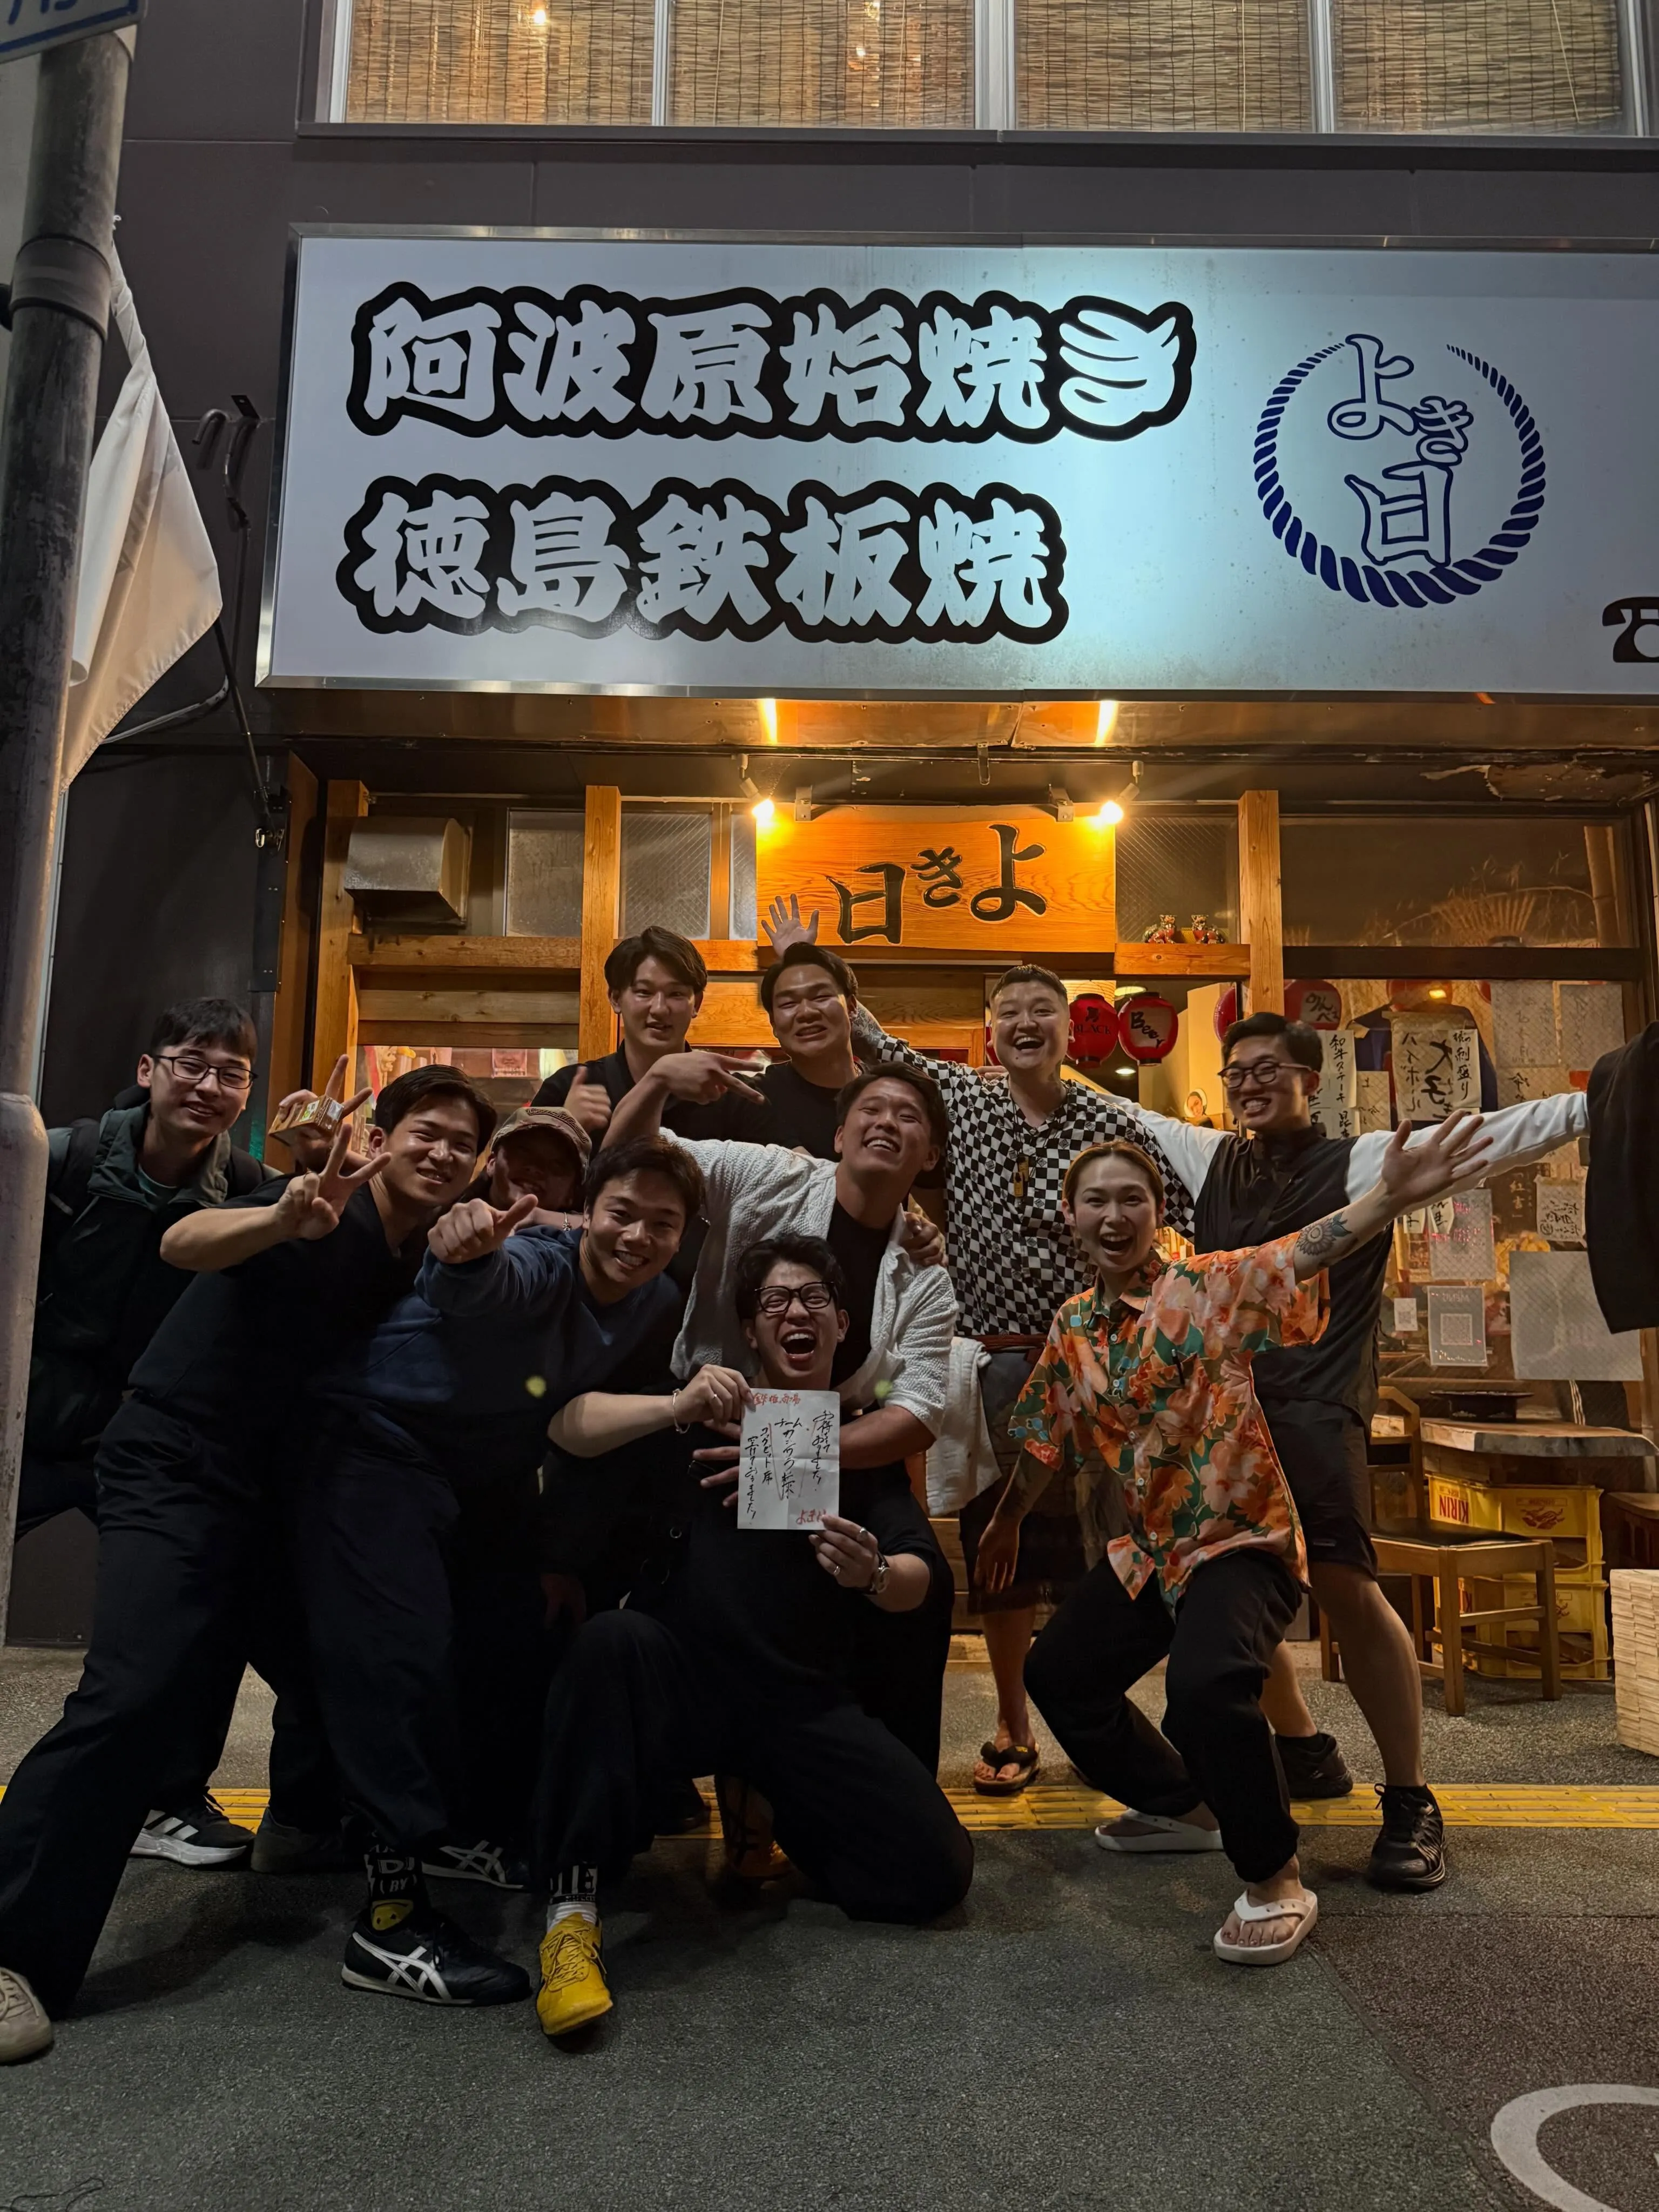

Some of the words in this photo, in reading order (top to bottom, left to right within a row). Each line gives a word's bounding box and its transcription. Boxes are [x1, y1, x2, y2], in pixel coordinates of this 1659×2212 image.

[347, 282, 1195, 442] 阿波原始焼き
[336, 474, 1068, 644] 徳島鉄板焼
[1130, 1010, 1165, 1048] Beer
[1330, 1035, 1348, 1104] 和牛ステーキ
[1439, 1495, 1469, 1524] KIRIN
